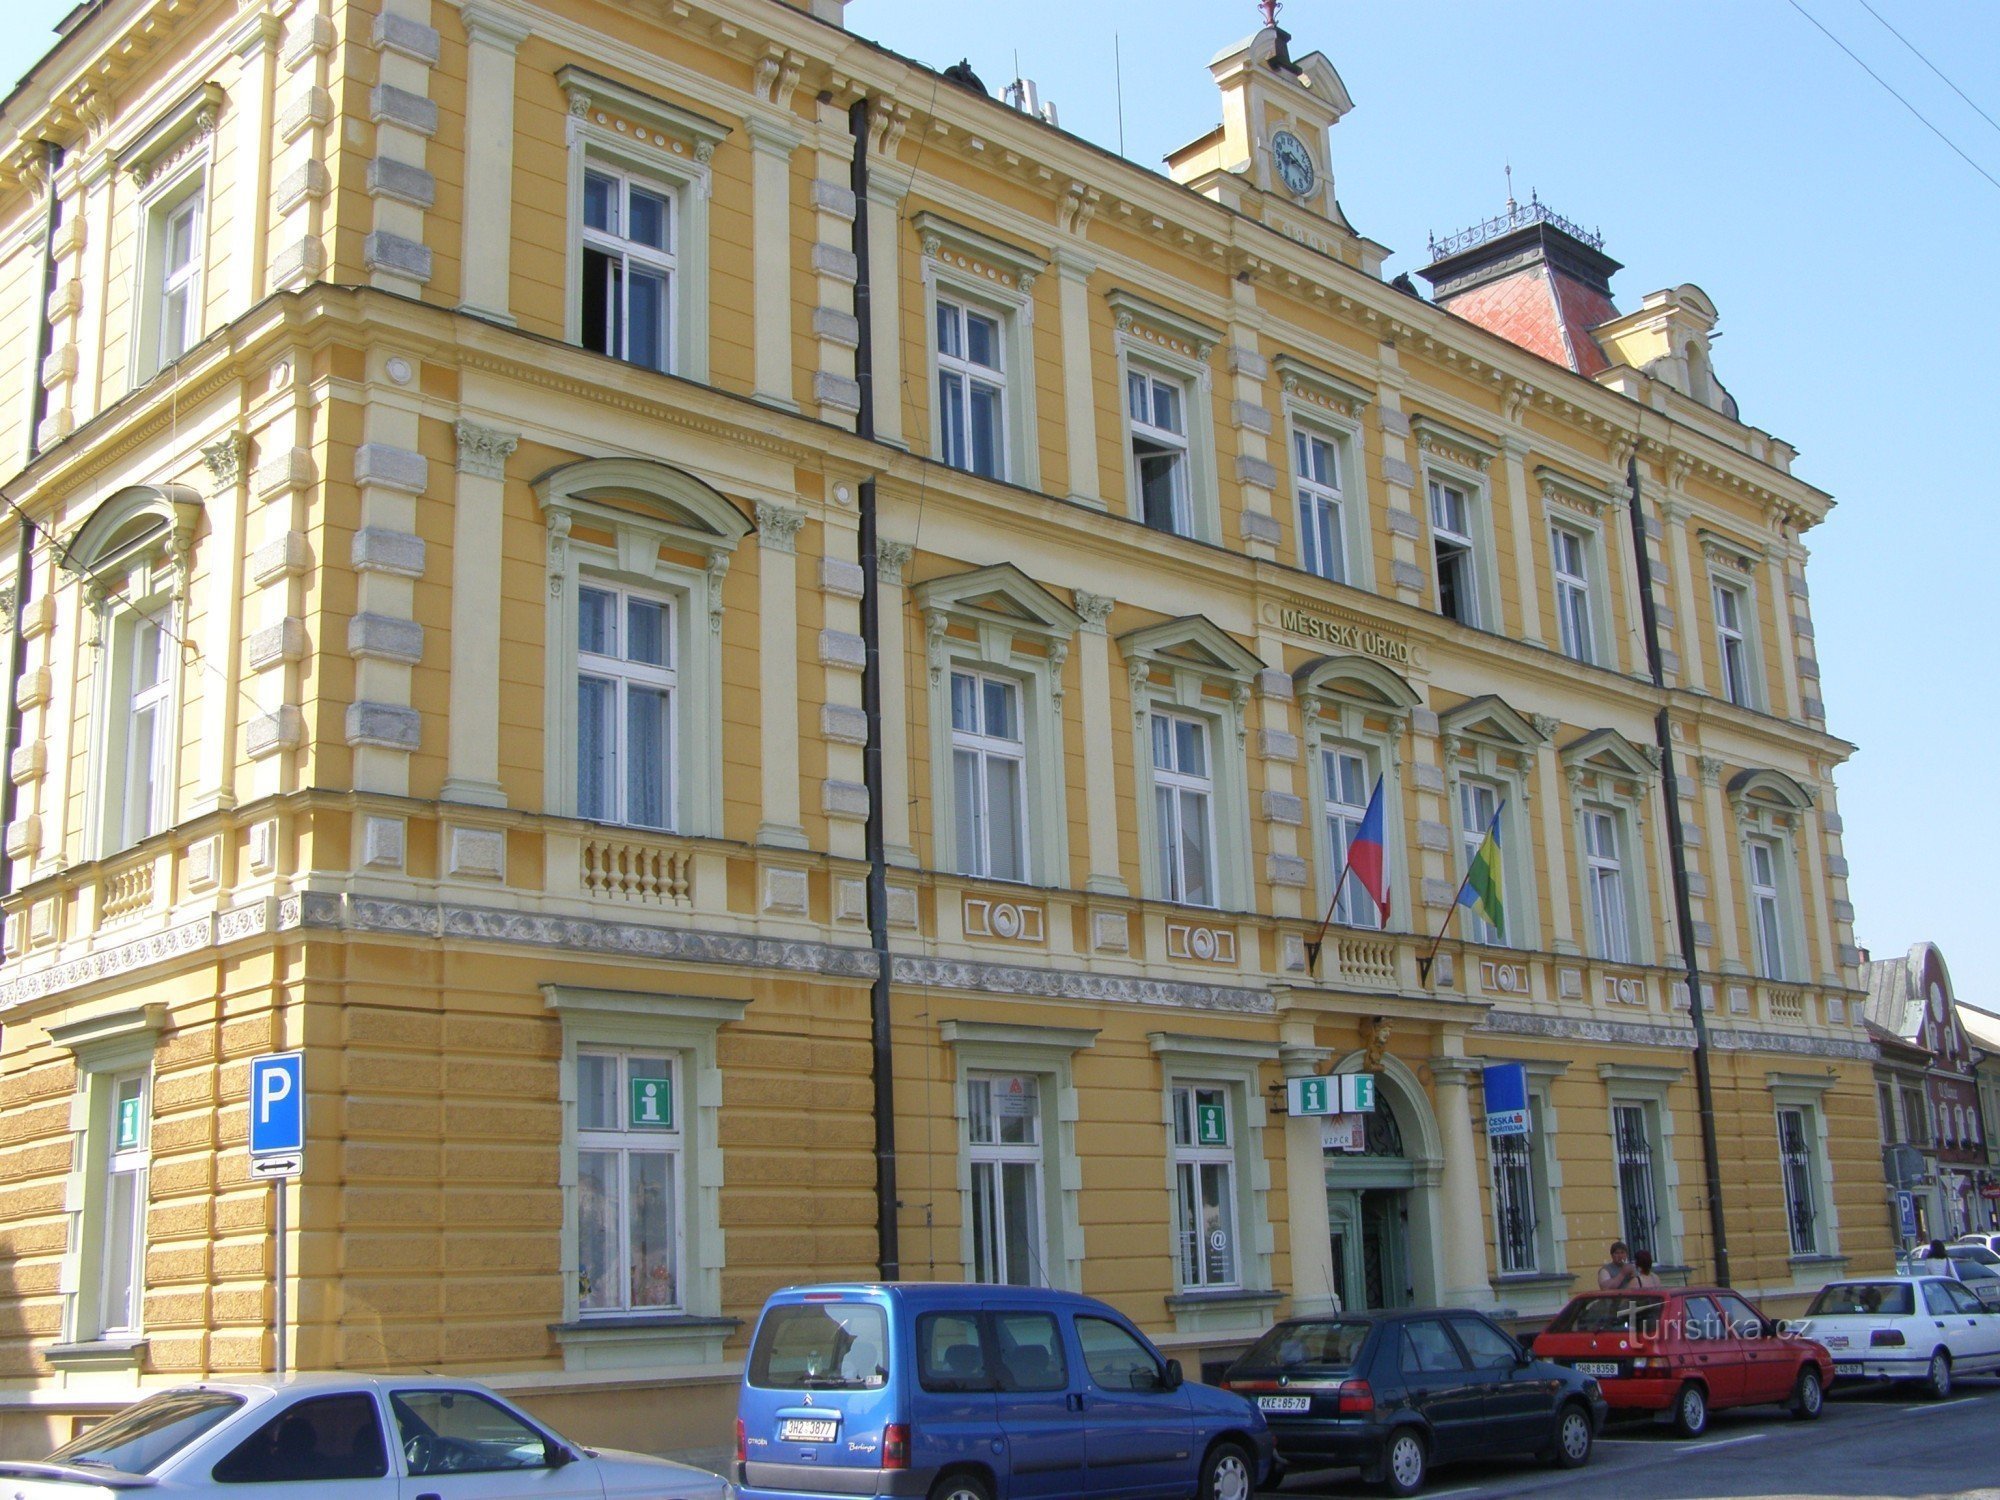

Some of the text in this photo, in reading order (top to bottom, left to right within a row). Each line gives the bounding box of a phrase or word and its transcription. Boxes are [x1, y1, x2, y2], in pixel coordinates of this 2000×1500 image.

[1282, 608, 1409, 663] MĚSTSKÝ ÚŘAD
[261, 1067, 292, 1124] P
[1900, 1196, 1910, 1222] P
[810, 1420, 833, 1435] 3877
